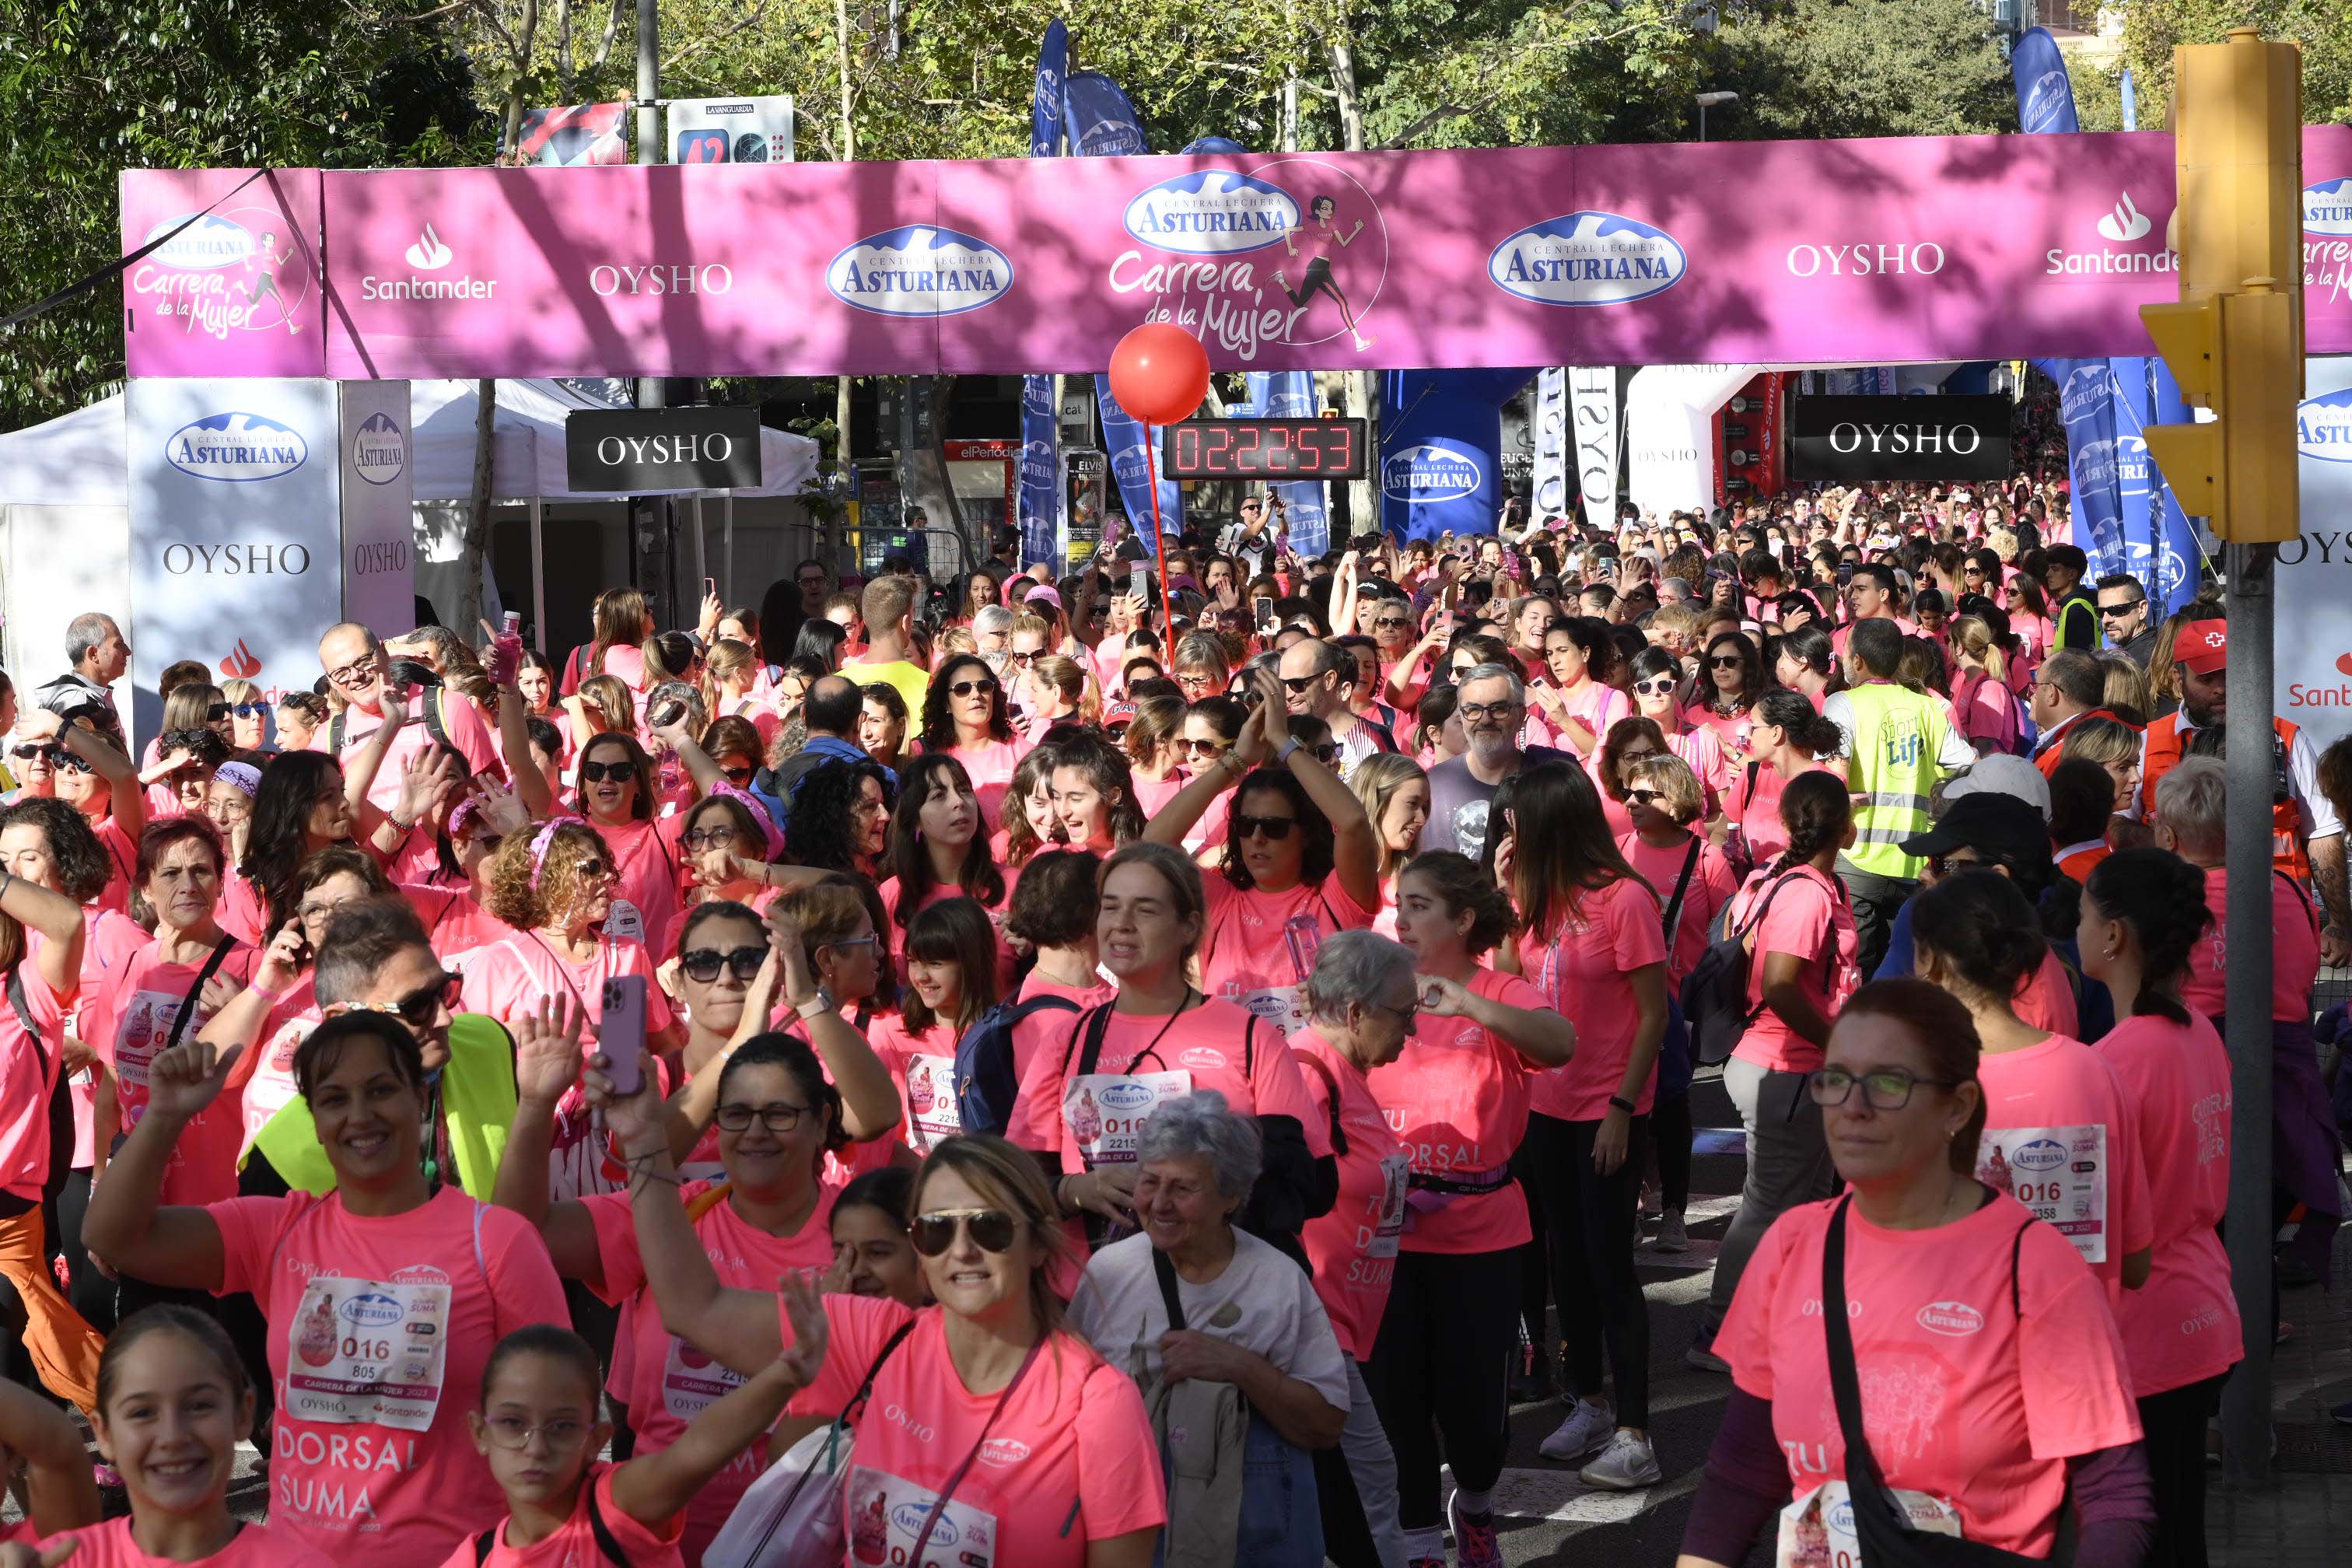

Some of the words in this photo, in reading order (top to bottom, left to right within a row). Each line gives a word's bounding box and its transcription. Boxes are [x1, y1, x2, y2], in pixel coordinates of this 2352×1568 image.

[1225, 198, 1283, 207] LECHERA
[1137, 201, 1286, 233] ASTURIANA
[1534, 245, 1595, 255] CENTRAL
[1601, 243, 1665, 254] LECHERA
[1787, 242, 1945, 277] OYSHO
[2046, 247, 2179, 275] Santande
[841, 259, 999, 293] ASTURIANA
[1108, 250, 1257, 294] Carrera
[1503, 248, 1671, 282] ASTURIANA
[133, 264, 225, 295] Carrera
[362, 275, 498, 301] Santander
[589, 263, 733, 296] OYSHO
[156, 302, 173, 315] de
[176, 299, 189, 316] la
[187, 291, 260, 340] Mujer
[1144, 296, 1171, 324] de
[1177, 296, 1197, 326] la
[1198, 288, 1308, 362] Mujer
[177, 437, 298, 464] ASTURIANA
[597, 432, 733, 465] OYSHO
[1176, 427, 1350, 471] 02:22:53
[1829, 422, 1980, 455] OYSHO
[357, 439, 402, 467] ASTURIANA
[1078, 460, 1102, 471] ELVIS
[1638, 448, 1698, 463] OYSHO
[1385, 467, 1473, 490] ASTURIANA
[163, 544, 310, 576] OYSHO
[355, 540, 406, 576] OYSHO
[450, 933, 478, 947] YSHO
[1102, 1092, 1150, 1104] ASTURIANA
[1399, 1141, 1483, 1165] ORSAL
[2017, 1151, 2063, 1164] ASTURIANA
[2018, 1181, 2061, 1202] 016
[344, 1304, 400, 1321] ASTURIANA
[410, 1304, 437, 1313] SUMA
[341, 1337, 390, 1360] 016
[352, 1365, 375, 1379] 805
[304, 1380, 344, 1391] CARRERA
[345, 1384, 358, 1393] DE
[300, 1397, 346, 1414] OYSHO
[383, 1403, 429, 1419] Santander
[278, 1426, 421, 1472] DORSAL
[1783, 1440, 1828, 1477] TU
[279, 1473, 377, 1519] SUMA
